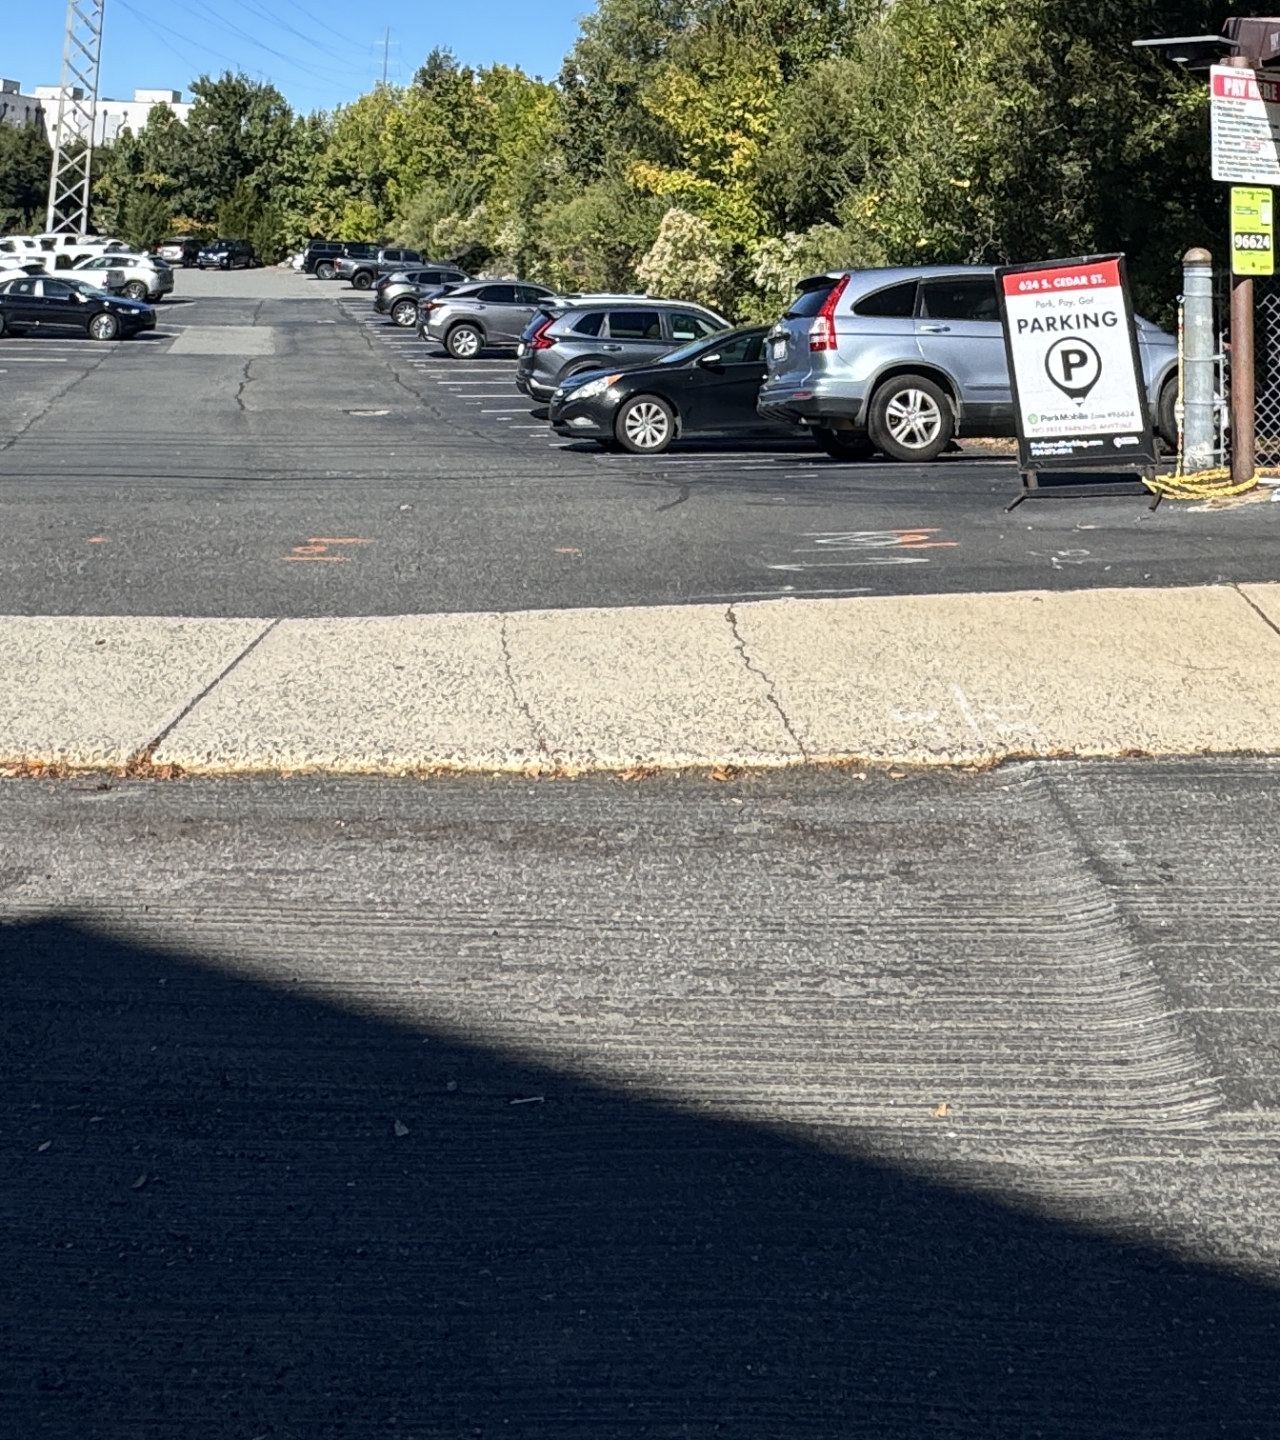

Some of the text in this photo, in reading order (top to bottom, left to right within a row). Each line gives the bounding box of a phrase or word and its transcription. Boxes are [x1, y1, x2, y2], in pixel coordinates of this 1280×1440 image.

[1223, 78, 1278, 100] PAY HERE
[1234, 234, 1270, 249] 96624
[1019, 273, 1107, 291] 624 S. CEDAR ST.
[1017, 311, 1118, 334] PARKING
[1060, 349, 1088, 382] P
